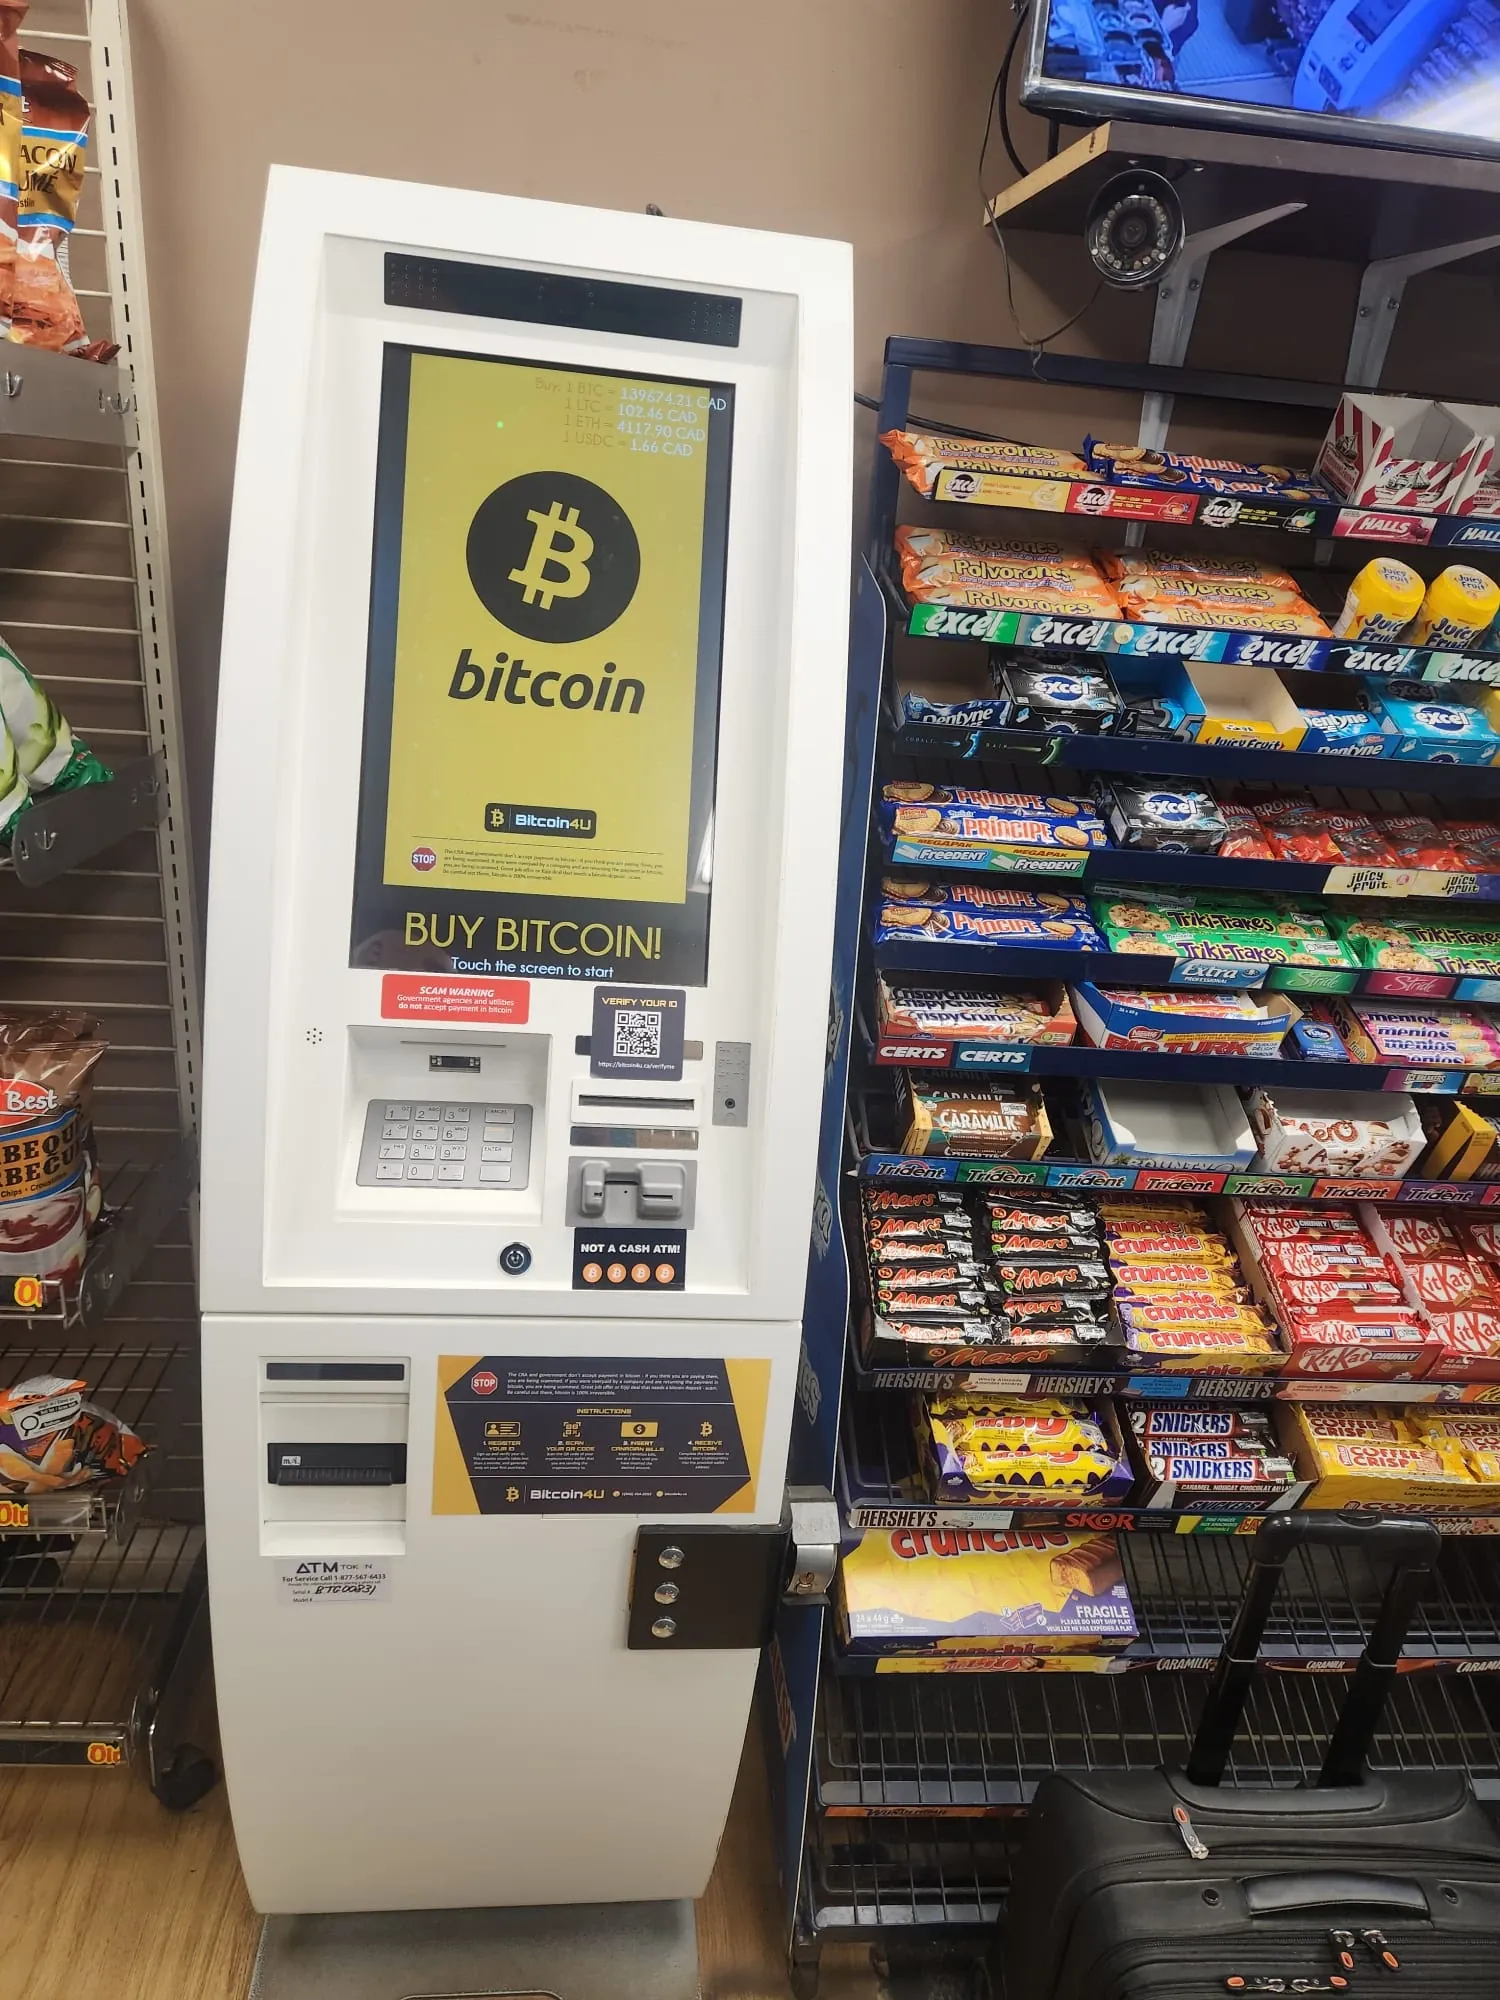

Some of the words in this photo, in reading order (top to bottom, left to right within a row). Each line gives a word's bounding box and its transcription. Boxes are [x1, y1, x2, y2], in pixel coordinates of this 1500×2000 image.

[20, 145, 77, 175] ACON
[578, 382, 604, 398] BTC
[620, 386, 693, 408] 139674.21
[697, 396, 727, 411] CAD
[576, 399, 602, 413] LTC
[667, 410, 698, 425] CAD
[576, 415, 602, 430] ETH
[675, 427, 707, 442] CAD
[575, 432, 614, 448] USDC
[630, 438, 660, 454] 1.66
[662, 443, 694, 457] CAD
[1358, 517, 1411, 535] HALLS
[966, 590, 1093, 616] Polvorones
[925, 608, 1002, 638] excel
[1030, 618, 1107, 648] excel
[1239, 638, 1319, 668] excel
[1344, 648, 1415, 673] excel
[447, 648, 646, 715] bitcoin
[1033, 680, 1091, 697] excel
[1414, 709, 1472, 726] excel
[1144, 798, 1198, 816] excel
[514, 812, 592, 832] Bitcoin4U
[916, 838, 974, 849] MEGAPAK
[412, 853, 436, 865] STOP
[1012, 848, 1069, 858] MEGAPAK
[1168, 910, 1276, 933] Triki-Trakes
[404, 911, 485, 950] BUY
[495, 916, 662, 961] BITCOIN!
[1176, 940, 1286, 964] Triki-Trakes
[451, 956, 491, 973] Touch
[495, 959, 516, 973] the
[520, 963, 564, 977] screen
[567, 964, 581, 977] to
[584, 965, 615, 979] start
[1181, 960, 1238, 980] Extra
[396, 994, 442, 1004] Government
[442, 997, 473, 1006] agencies
[473, 997, 488, 1006] and
[419, 986, 447, 997] SCAM
[448, 987, 495, 998] WARNING
[398, 1002, 409, 1010] do
[410, 1003, 423, 1011] not
[423, 1003, 447, 1013] accept
[447, 1004, 479, 1015] payment
[488, 1005, 513, 1015] bitcoin
[601, 996, 638, 1007] VERIFY
[639, 999, 667, 1008] YOUR
[668, 1000, 678, 1008] ID
[1377, 1025, 1450, 1038] mentos
[879, 1046, 947, 1060] CERTS
[1384, 1038, 1457, 1052] mentos
[959, 1050, 1027, 1064] CERTS
[6, 1088, 59, 1114] Best
[939, 1110, 1018, 1132] CARAMILK
[877, 1162, 947, 1180] Trident
[966, 1168, 1037, 1186] Trident
[1059, 1172, 1127, 1190] Trident
[1146, 1175, 1214, 1193] Trident
[1234, 1181, 1301, 1197] Trident
[0, 1188, 24, 1200] Chips
[1323, 1185, 1389, 1200] Trident
[1407, 1188, 1476, 1203] Trident
[879, 1217, 943, 1238] Mars
[1002, 1208, 1070, 1230] Mars
[1259, 1217, 1300, 1236] KitKat
[1299, 1219, 1329, 1228] CHUNKY
[580, 1243, 605, 1255] NOT
[607, 1243, 617, 1254] A
[618, 1243, 650, 1255] CASH
[653, 1244, 681, 1256] ATM!
[1006, 1233, 1070, 1253] Mars
[1112, 1234, 1202, 1255] crunchie
[1118, 1262, 1210, 1284] crunchie
[1286, 1254, 1328, 1274] KitKat
[1327, 1256, 1359, 1265] CHUNKY
[891, 1267, 958, 1290] Mars
[1013, 1266, 1079, 1291] Mars
[1416, 1263, 1472, 1301] KitKat
[1297, 1280, 1338, 1298] KitKat
[1337, 1282, 1369, 1290] CHUNKY
[890, 1291, 958, 1313] Mars
[1143, 1301, 1240, 1323] crunchie
[1150, 1329, 1247, 1349] crunchie
[1359, 1327, 1392, 1338] CHUNKY
[932, 1348, 1056, 1367] Mars
[1305, 1348, 1371, 1372] KitKat
[1371, 1352, 1420, 1362] CHUNKY
[473, 1377, 496, 1389] STOP
[875, 1373, 955, 1390] HERSHEY'S
[1036, 1375, 1116, 1394] HERSHEY'S
[1195, 1379, 1275, 1398] HERSHEY'S
[576, 1407, 633, 1416] INSTRUCTIONS
[1151, 1411, 1231, 1433] SNICKERS
[1310, 1418, 1377, 1430] COFFEE
[1314, 1428, 1367, 1438] CRISP
[1151, 1441, 1228, 1457] SNICKERS
[1350, 1446, 1422, 1460] COFFEE
[1172, 1459, 1254, 1480] SNICKERS
[1354, 1456, 1409, 1469] CRISP
[529, 1488, 605, 1500] Bitcoin4U
[858, 1510, 938, 1528] HERSHEY'S
[1064, 1512, 1137, 1531] SKOR
[296, 1561, 339, 1574] ATM
[1075, 1605, 1130, 1619] FRAGILE
[1156, 1657, 1213, 1672] CARAMILK
[1305, 1660, 1346, 1670] CARAMILK
